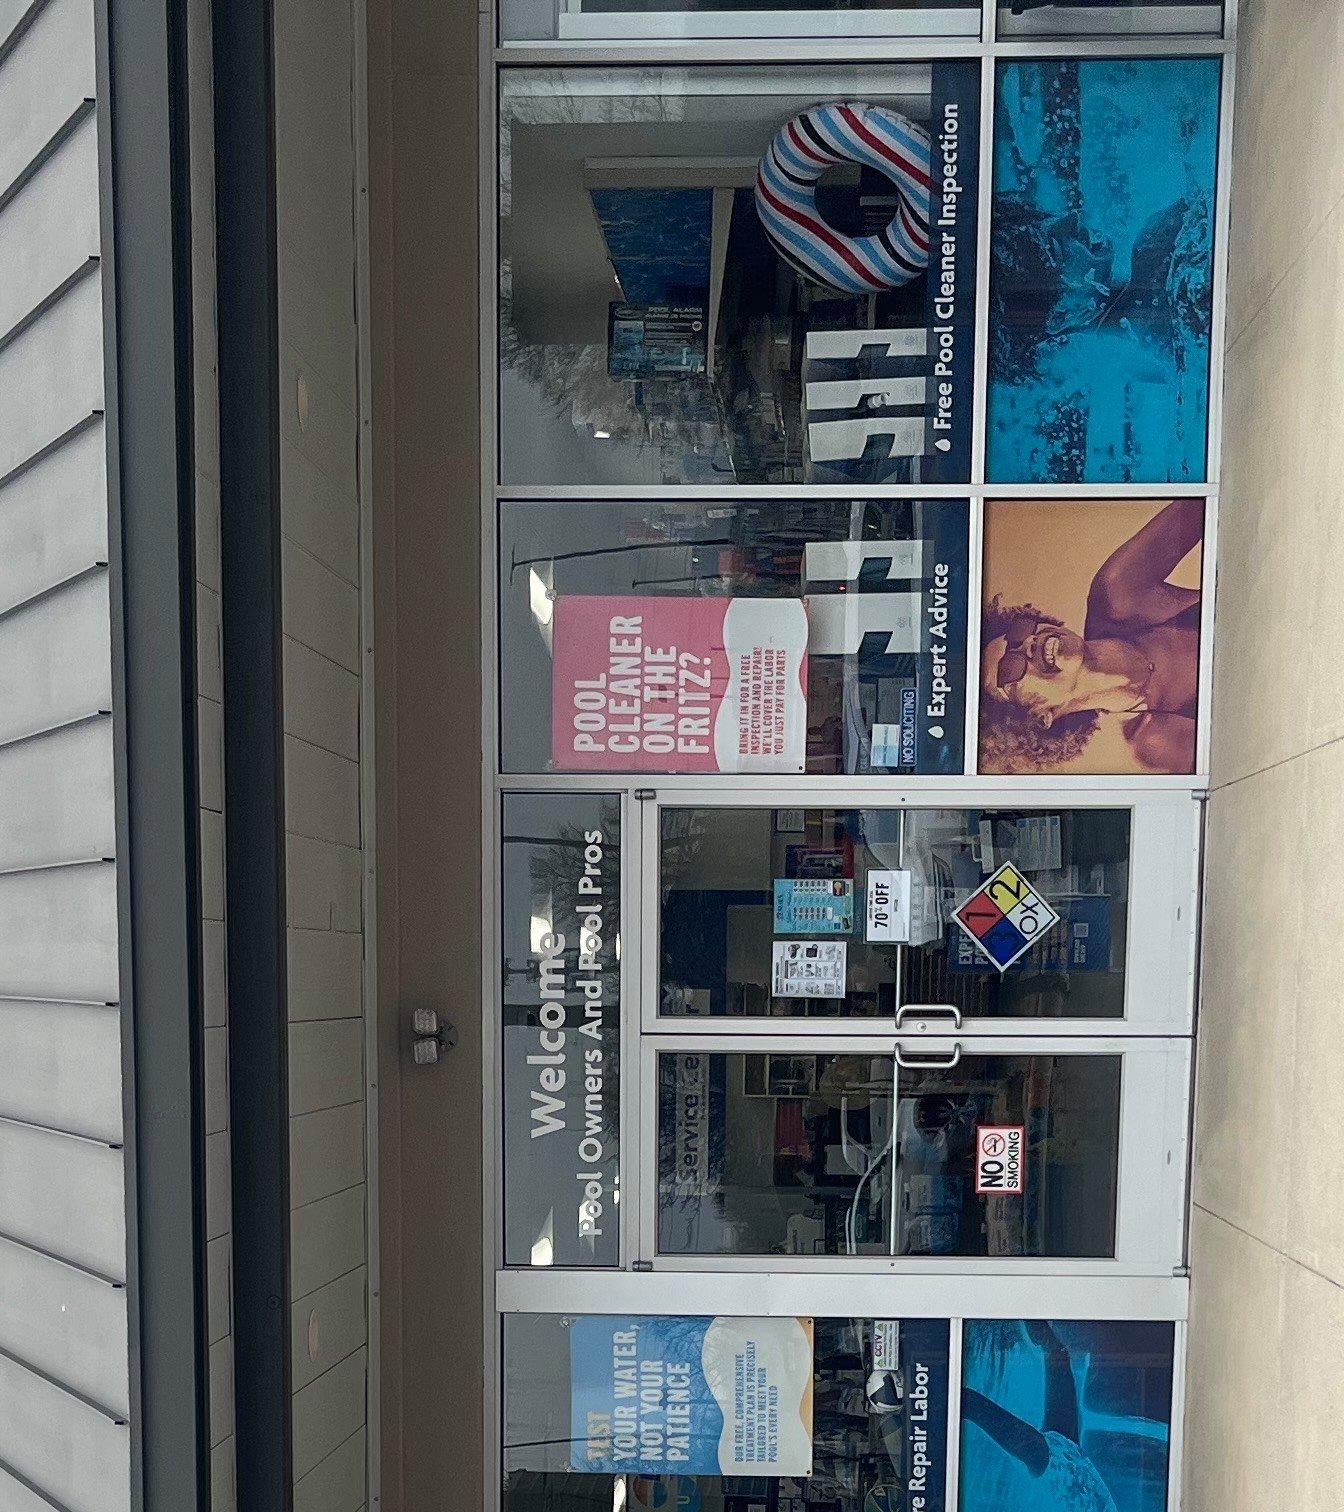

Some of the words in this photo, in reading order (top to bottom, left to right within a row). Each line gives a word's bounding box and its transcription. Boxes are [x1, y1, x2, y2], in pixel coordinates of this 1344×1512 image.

[938, 104, 962, 225] Inspection
[937, 232, 956, 319] Cleaner
[934, 325, 954, 376] Pool
[934, 383, 954, 430] Free
[928, 563, 949, 639] Advice
[643, 646, 677, 702] THE
[741, 655, 750, 676] FREE
[764, 649, 774, 678] LABOR
[776, 650, 786, 677] PARTS
[927, 644, 952, 717] Expert
[608, 615, 642, 753] CLEANER
[677, 652, 712, 754] FRITZ?
[740, 686, 750, 703] FOR
[752, 683, 761, 701] AND
[764, 680, 773, 696] THE
[776, 679, 785, 695] FOR
[573, 673, 606, 752] POOL
[739, 717, 749, 725] IT
[740, 705, 749, 715] IN
[763, 698, 773, 726] COVER
[775, 697, 785, 714] PAY
[903, 691, 915, 746] SOLICITING
[643, 713, 675, 753] ON
[739, 727, 749, 754] BRING
[750, 704, 761, 755] INSPECTION
[763, 729, 772, 754] WE'LL
[775, 716, 784, 736] JUST
[774, 738, 784, 755] YOU
[902, 747, 914, 763] NO
[578, 830, 603, 894] Pros
[875, 882, 889, 904] OFF
[989, 880, 1021, 900] 2
[965, 912, 996, 921] 1
[1019, 901, 1039, 935] OX
[575, 904, 603, 970] Pool
[958, 927, 973, 965] EXPE
[576, 980, 603, 1040] And
[526, 932, 566, 1139] Welcome
[578, 1049, 603, 1163] Owners
[676, 1094, 699, 1182] Service
[980, 1160, 1004, 1188] NO
[1007, 1131, 1020, 1189] SMOKING
[576, 1171, 603, 1236] Pool
[612, 1324, 640, 1399] WATER,
[746, 1341, 755, 1382] PRECISELY
[757, 1367, 766, 1388] YOUR
[640, 1360, 664, 1415] YOUR
[735, 1354, 744, 1420] COMPREHENSIVE
[746, 1394, 755, 1415] PLAN
[757, 1390, 766, 1411] MEET
[768, 1385, 777, 1406] NEED
[909, 1363, 929, 1421] Labor
[666, 1362, 691, 1461] PATIENCE
[757, 1413, 766, 1423] TO
[768, 1408, 777, 1433] EVERY
[587, 1411, 611, 1461] TEST
[613, 1406, 637, 1462] YOUR
[640, 1421, 664, 1461] NOT
[745, 1417, 755, 1462] TREATMENT
[757, 1425, 766, 1462] TAILORED
[908, 1426, 931, 1490] Repair
